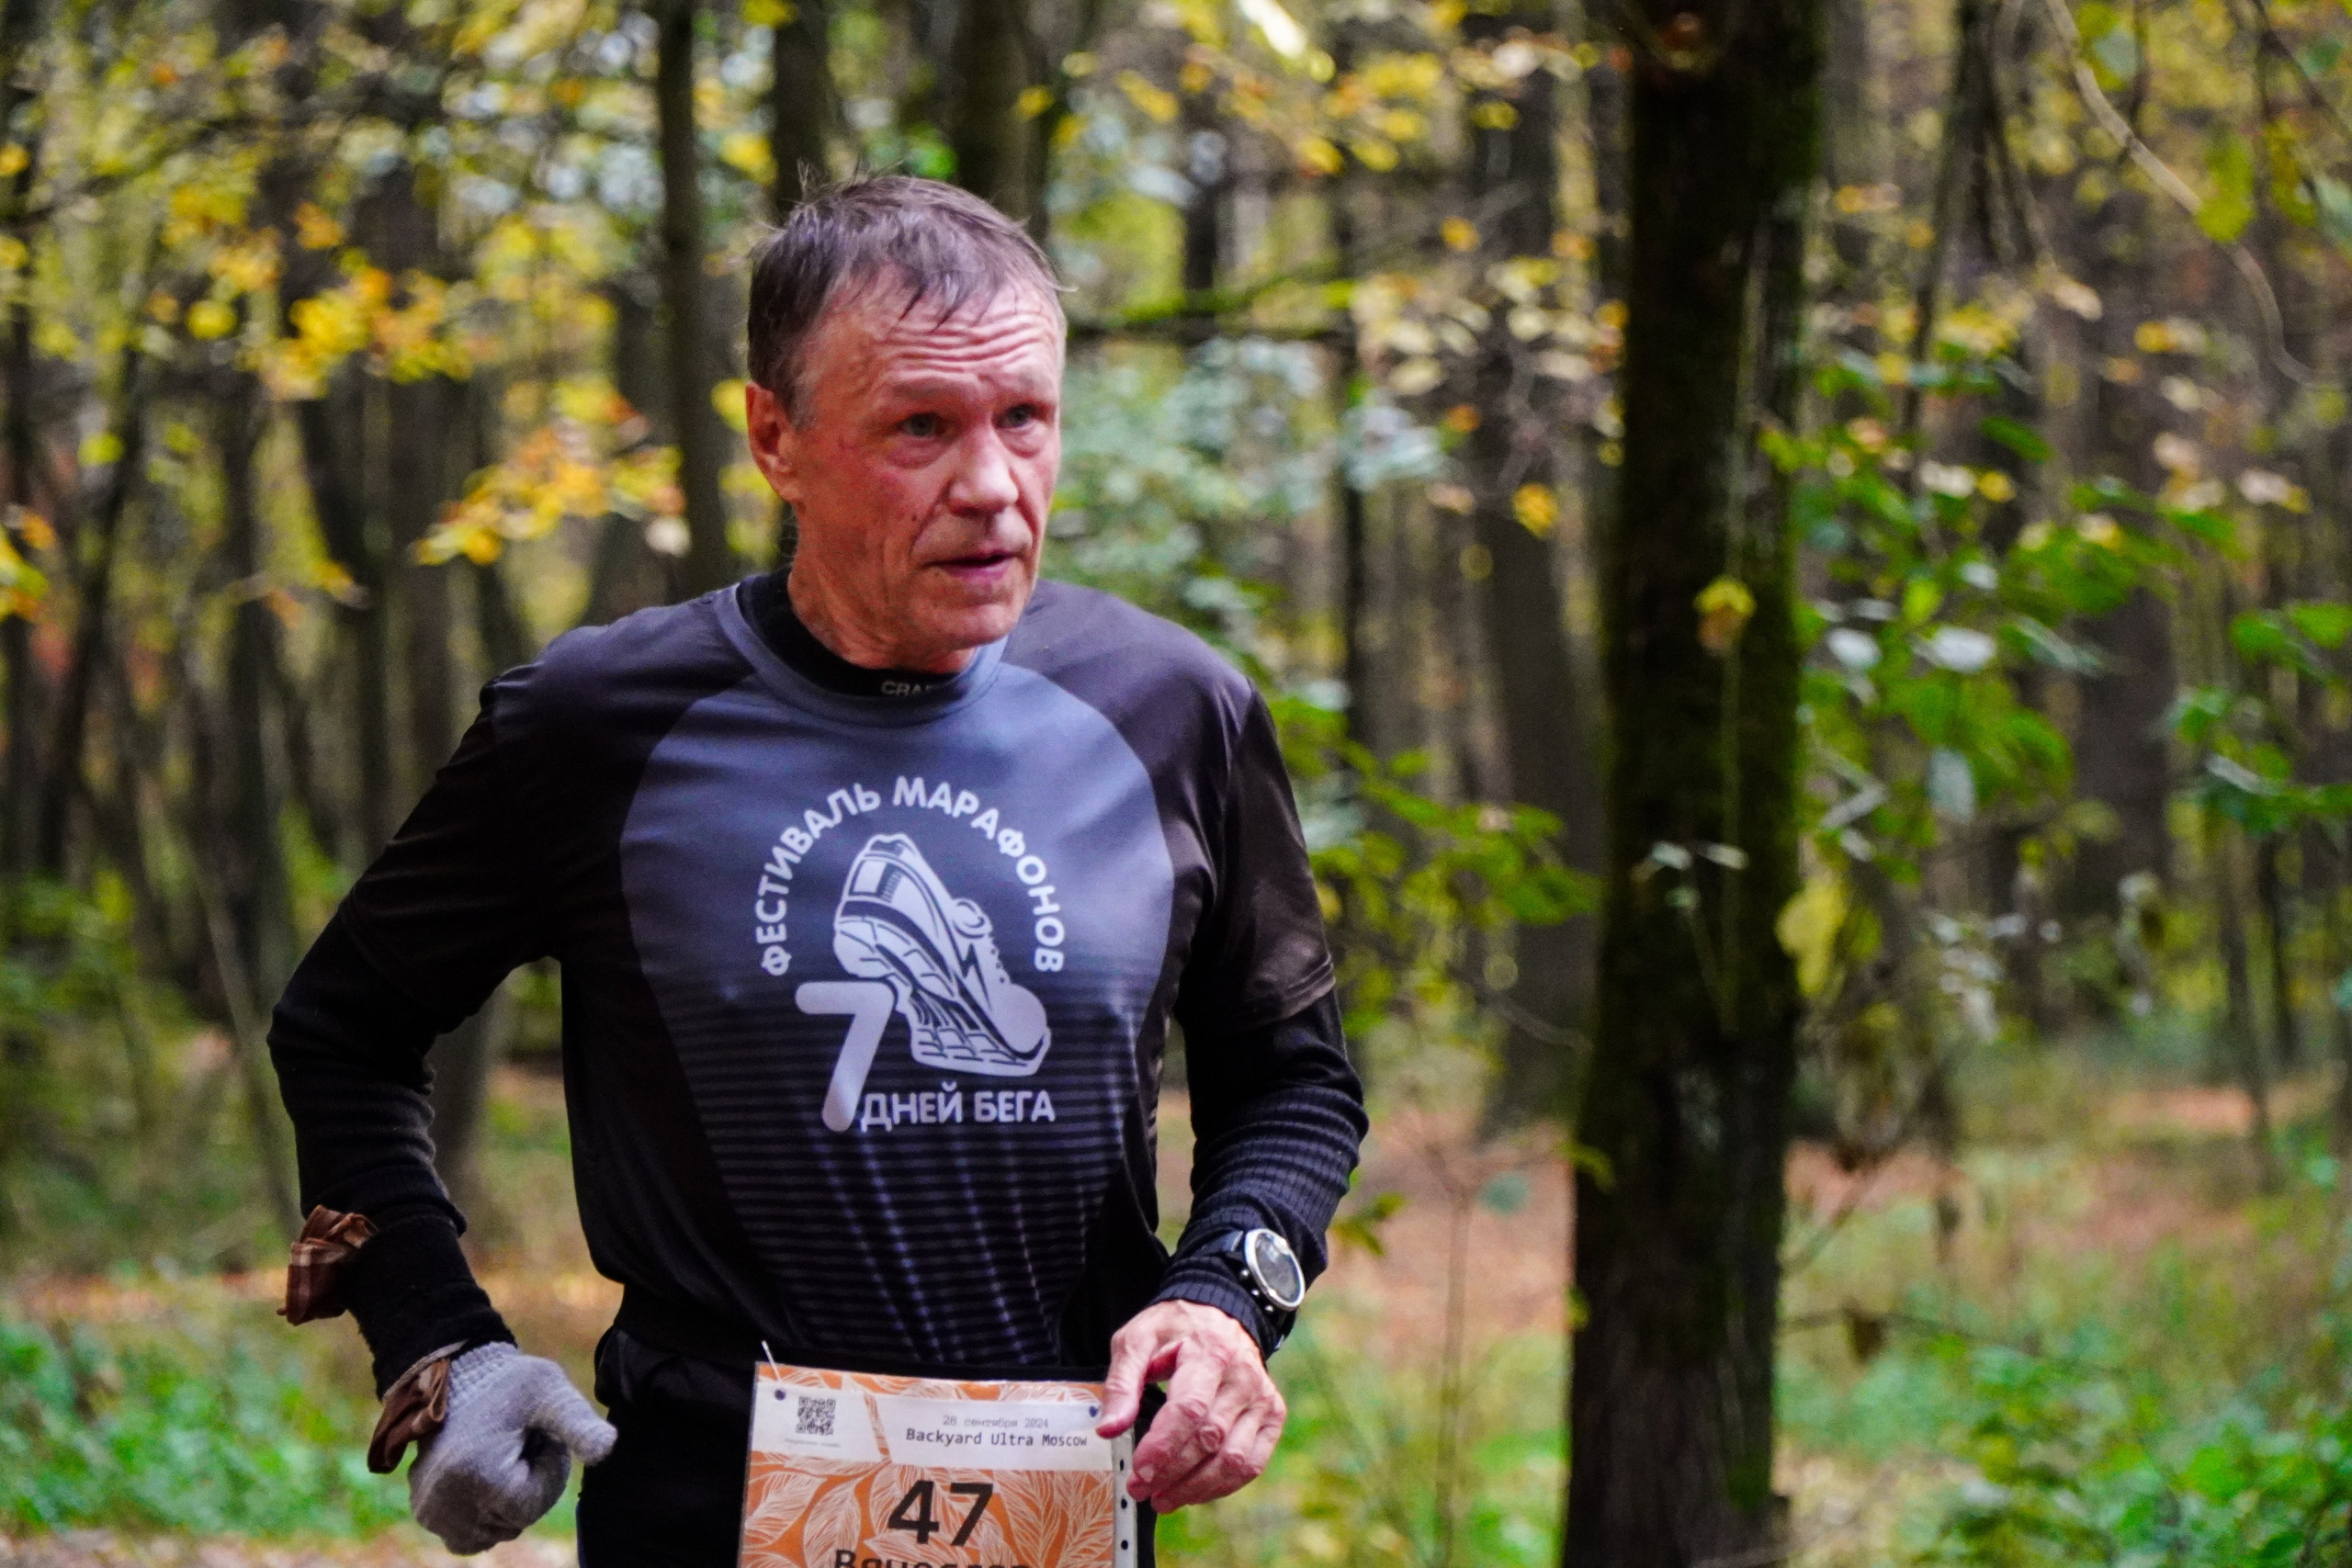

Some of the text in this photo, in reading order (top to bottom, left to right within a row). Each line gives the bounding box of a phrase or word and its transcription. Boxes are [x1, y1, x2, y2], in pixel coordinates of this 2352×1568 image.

[755, 775, 1065, 976] ФЕСТИВАЛЬ МАРАФОНОВ
[795, 980, 1056, 1133] 7 ДНЕЙ БЕГА
[906, 1427, 1088, 1447] Backyard Ultra Moscow
[943, 1416, 1049, 1429] 28 сентября 2024
[888, 1480, 994, 1547] 47
